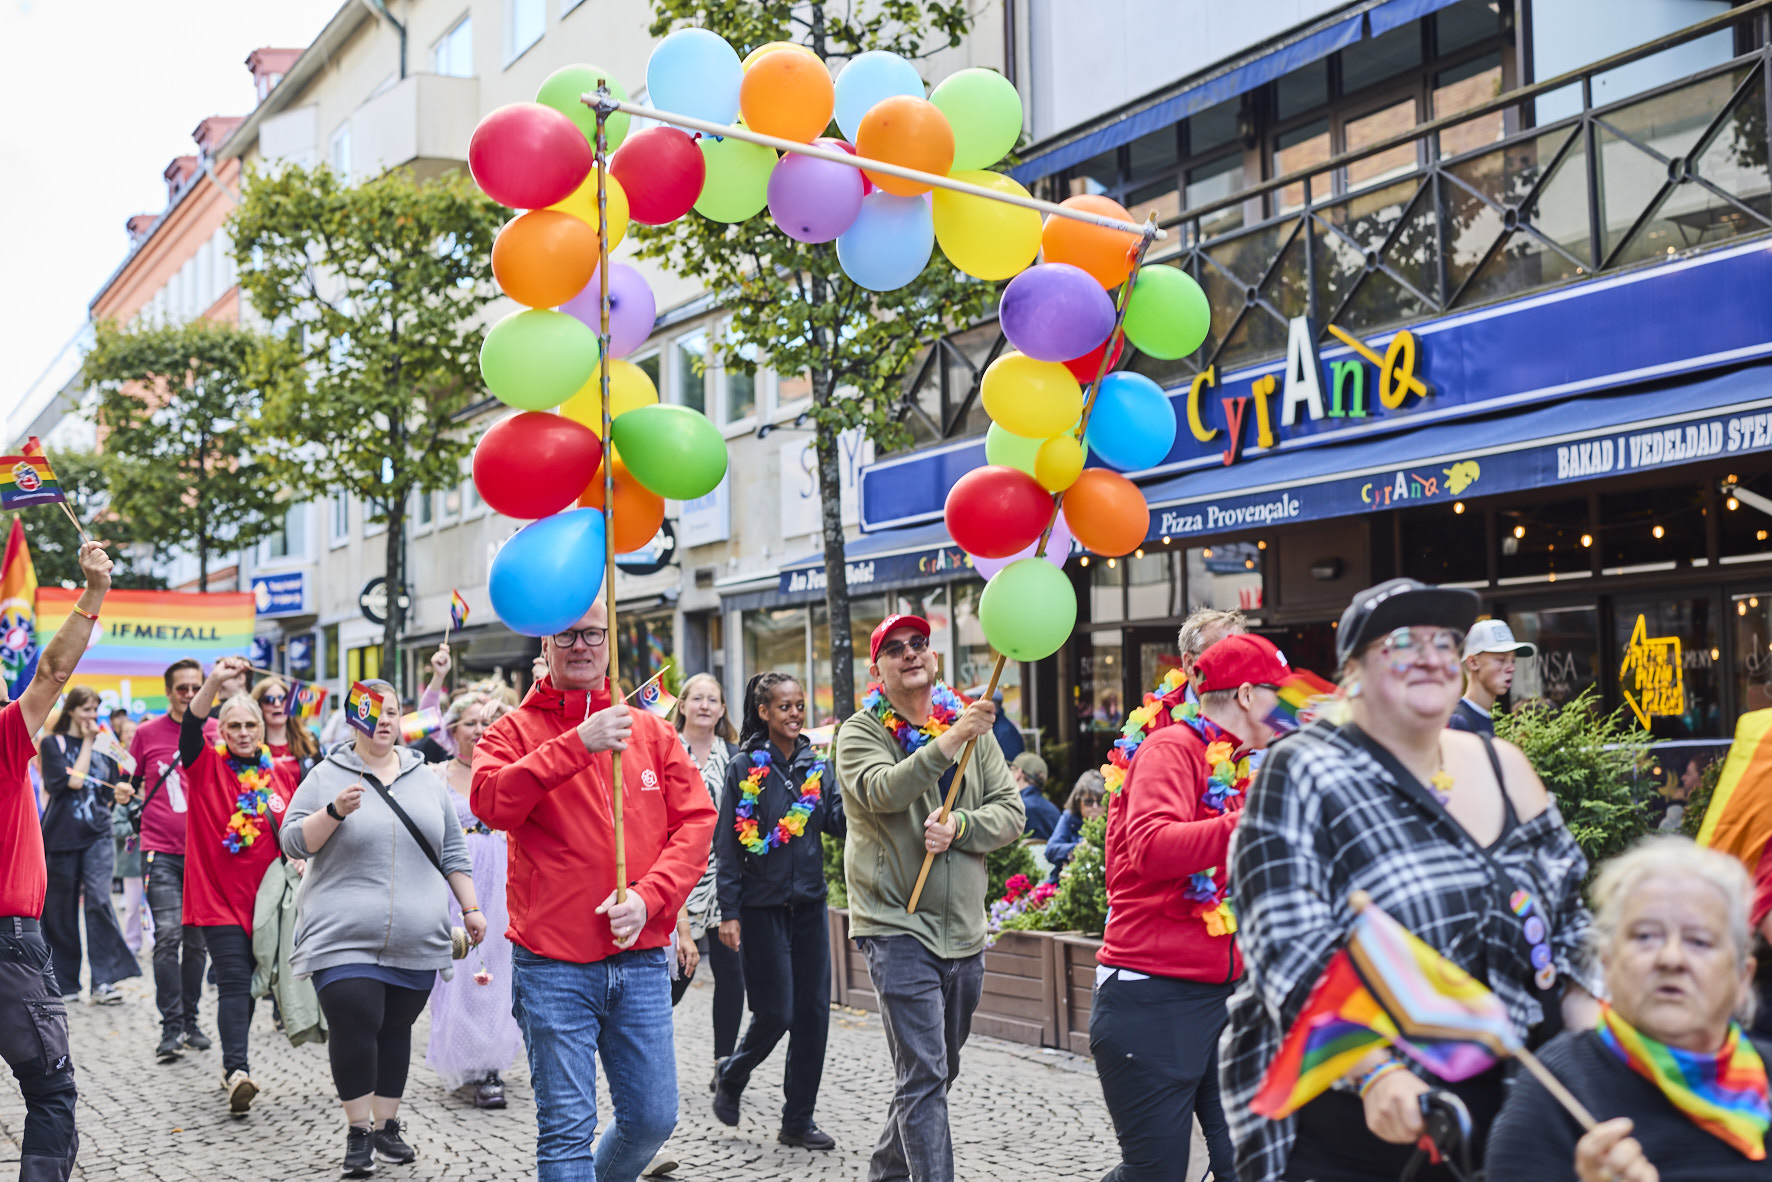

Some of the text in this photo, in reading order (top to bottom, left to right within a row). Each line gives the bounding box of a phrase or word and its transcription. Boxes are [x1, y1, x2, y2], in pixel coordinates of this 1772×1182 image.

[1557, 439, 1614, 479] BAKAD
[1617, 437, 1625, 470] I
[1629, 421, 1723, 468] VEDELDAD
[1159, 493, 1300, 534] Pizza Provençale
[788, 572, 807, 592] Au
